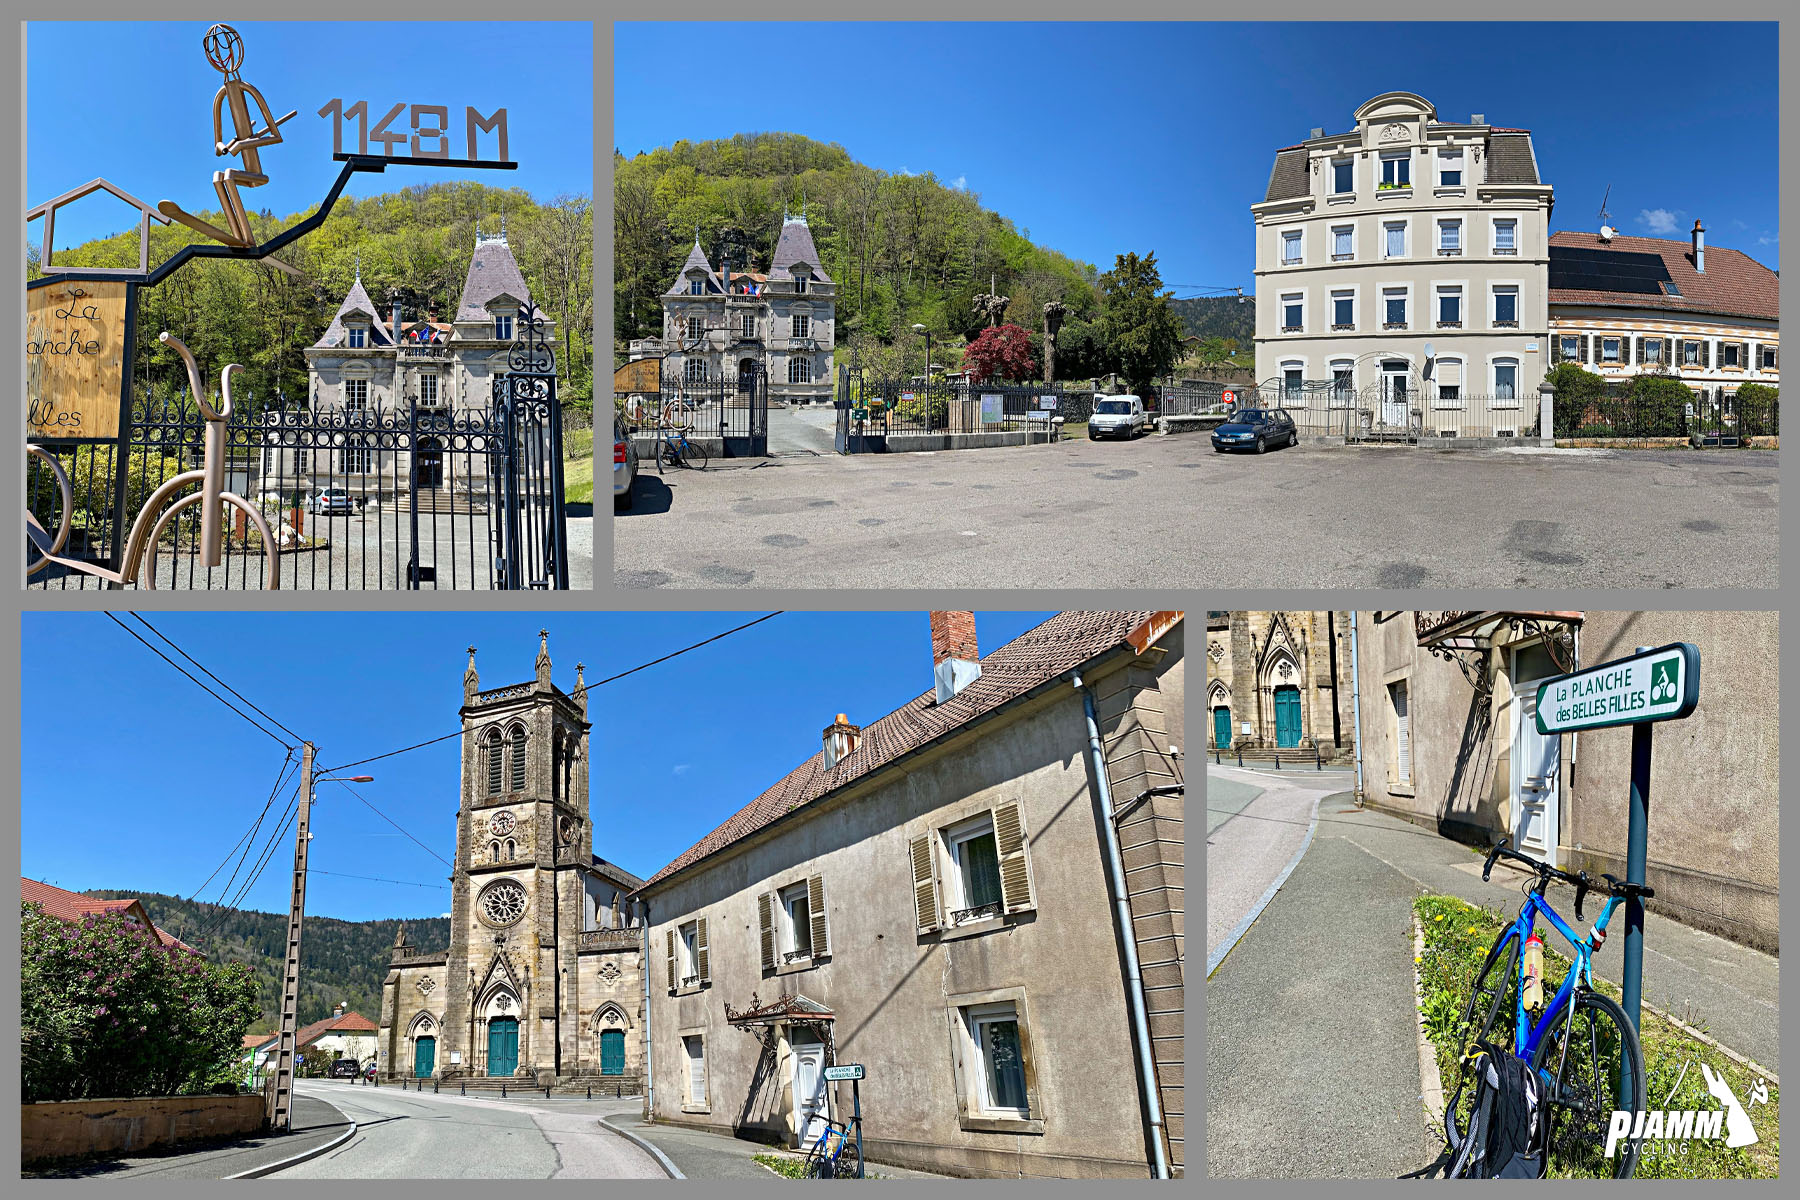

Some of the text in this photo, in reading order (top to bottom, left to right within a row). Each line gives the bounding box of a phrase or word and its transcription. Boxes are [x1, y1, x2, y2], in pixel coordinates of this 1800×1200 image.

[317, 98, 509, 161] 1148 M
[55, 288, 101, 321] La
[1556, 667, 1632, 703] La PLANCHE
[1556, 690, 1645, 723] des BELLES FILLES
